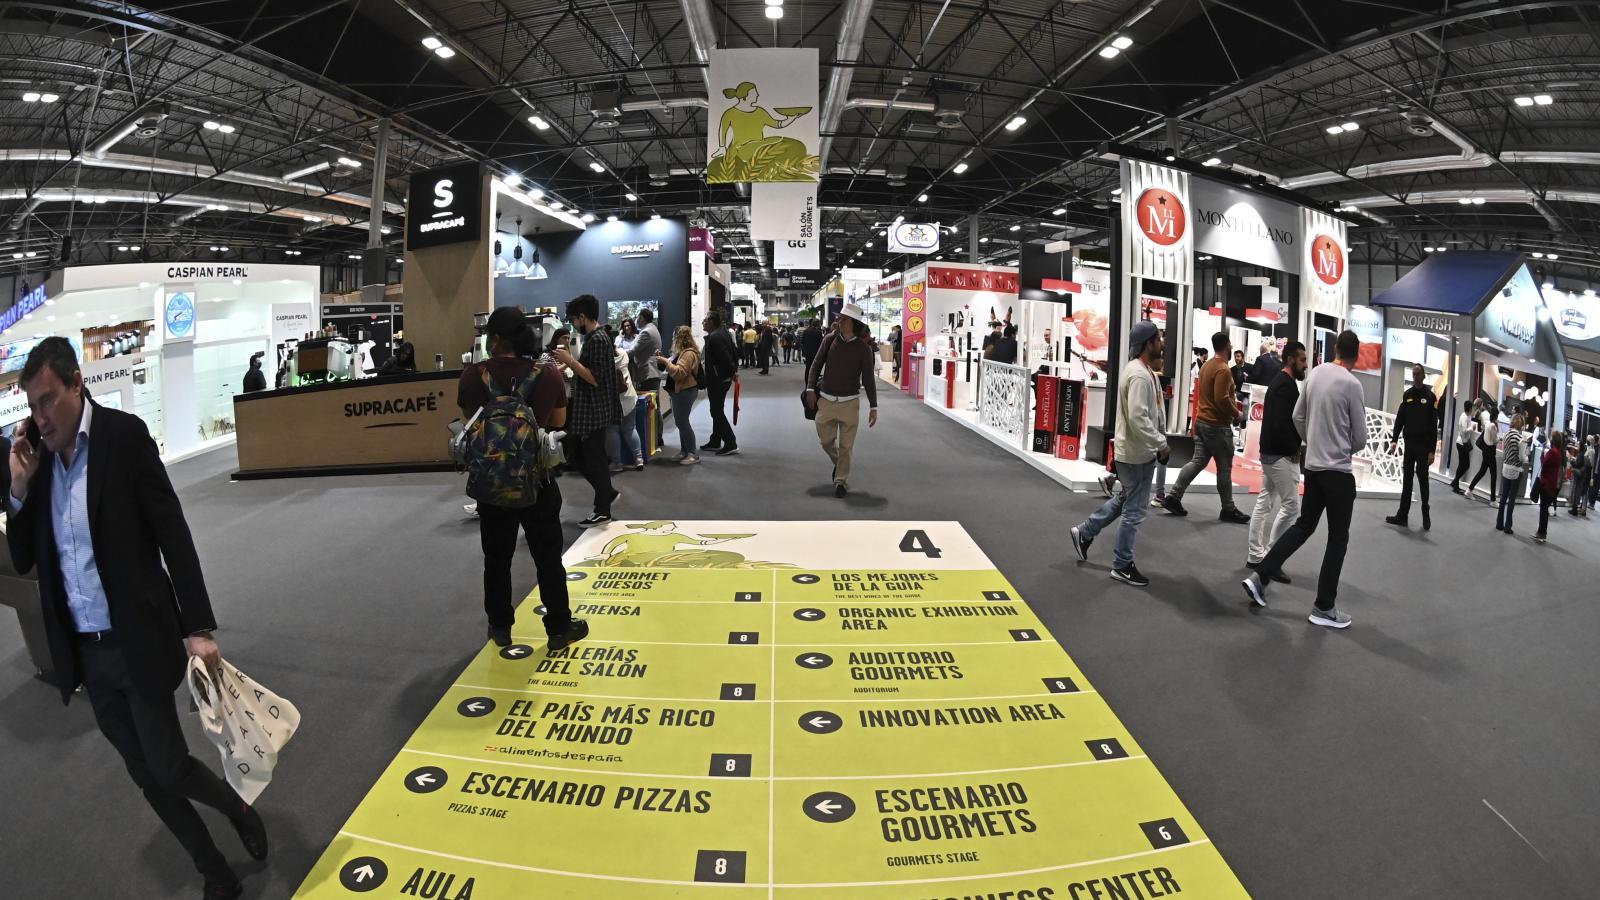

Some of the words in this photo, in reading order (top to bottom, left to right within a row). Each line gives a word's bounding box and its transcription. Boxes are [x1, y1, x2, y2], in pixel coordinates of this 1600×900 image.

[433, 179, 454, 208] S
[420, 217, 465, 233] SUPRACAFÉ
[610, 241, 661, 255] SUPRACAFÉ
[787, 239, 806, 249] GG
[167, 266, 214, 279] CASPIAN
[216, 266, 248, 278] PEARL
[18, 284, 48, 319] PEARL
[1401, 313, 1453, 332] NORDFISH
[104, 369, 130, 380] PEARL
[343, 391, 438, 418] SUPRACAFÉ
[898, 529, 943, 559] 4
[597, 571, 671, 582] GOURMET
[831, 573, 861, 582] LOS
[866, 572, 939, 582] MEJORES
[591, 580, 654, 590] QUESOS
[834, 582, 855, 591] DE
[860, 582, 880, 591] LA
[574, 604, 641, 616] PRENSA
[838, 607, 917, 618] ORGANIC
[923, 605, 1020, 617] EXHIBITION
[841, 619, 889, 631] AREA
[739, 634, 748, 642] 8
[545, 645, 639, 663] GALERÍAS
[848, 650, 956, 665] AUDITORIO
[535, 659, 571, 675] DEL
[579, 659, 648, 678] SALÓN
[850, 665, 964, 681] GOURMETS
[527, 678, 540, 686] THE
[541, 679, 579, 688] GALLERIES
[853, 686, 900, 694] AUDITORIUM
[1055, 680, 1067, 690] 8
[733, 687, 743, 697] 8
[507, 700, 533, 717] EL
[540, 701, 595, 722] PAÍS
[600, 703, 651, 725] MÁS
[658, 708, 716, 728] RICO
[859, 705, 1003, 728] INNOVATION
[1008, 703, 1066, 722] AREA
[495, 718, 537, 739] DEL
[545, 722, 633, 746] MUNDO
[498, 745, 624, 763] alimentosdespaña
[1101, 743, 1113, 755] 8
[725, 758, 737, 772] 8
[460, 771, 606, 808] ESCENARIO
[613, 785, 713, 814] PIZZAS
[874, 782, 1028, 814] ESCENARIO
[447, 802, 478, 815] PIZZAS
[479, 806, 509, 819] STAGE
[880, 808, 1037, 843] GOURMETS
[1158, 826, 1172, 842] 6
[713, 857, 729, 875] 8
[886, 853, 944, 867] GOURMETS
[946, 851, 980, 864] STAGE
[400, 867, 476, 900] AULA
[1067, 866, 1183, 900] CENTER
